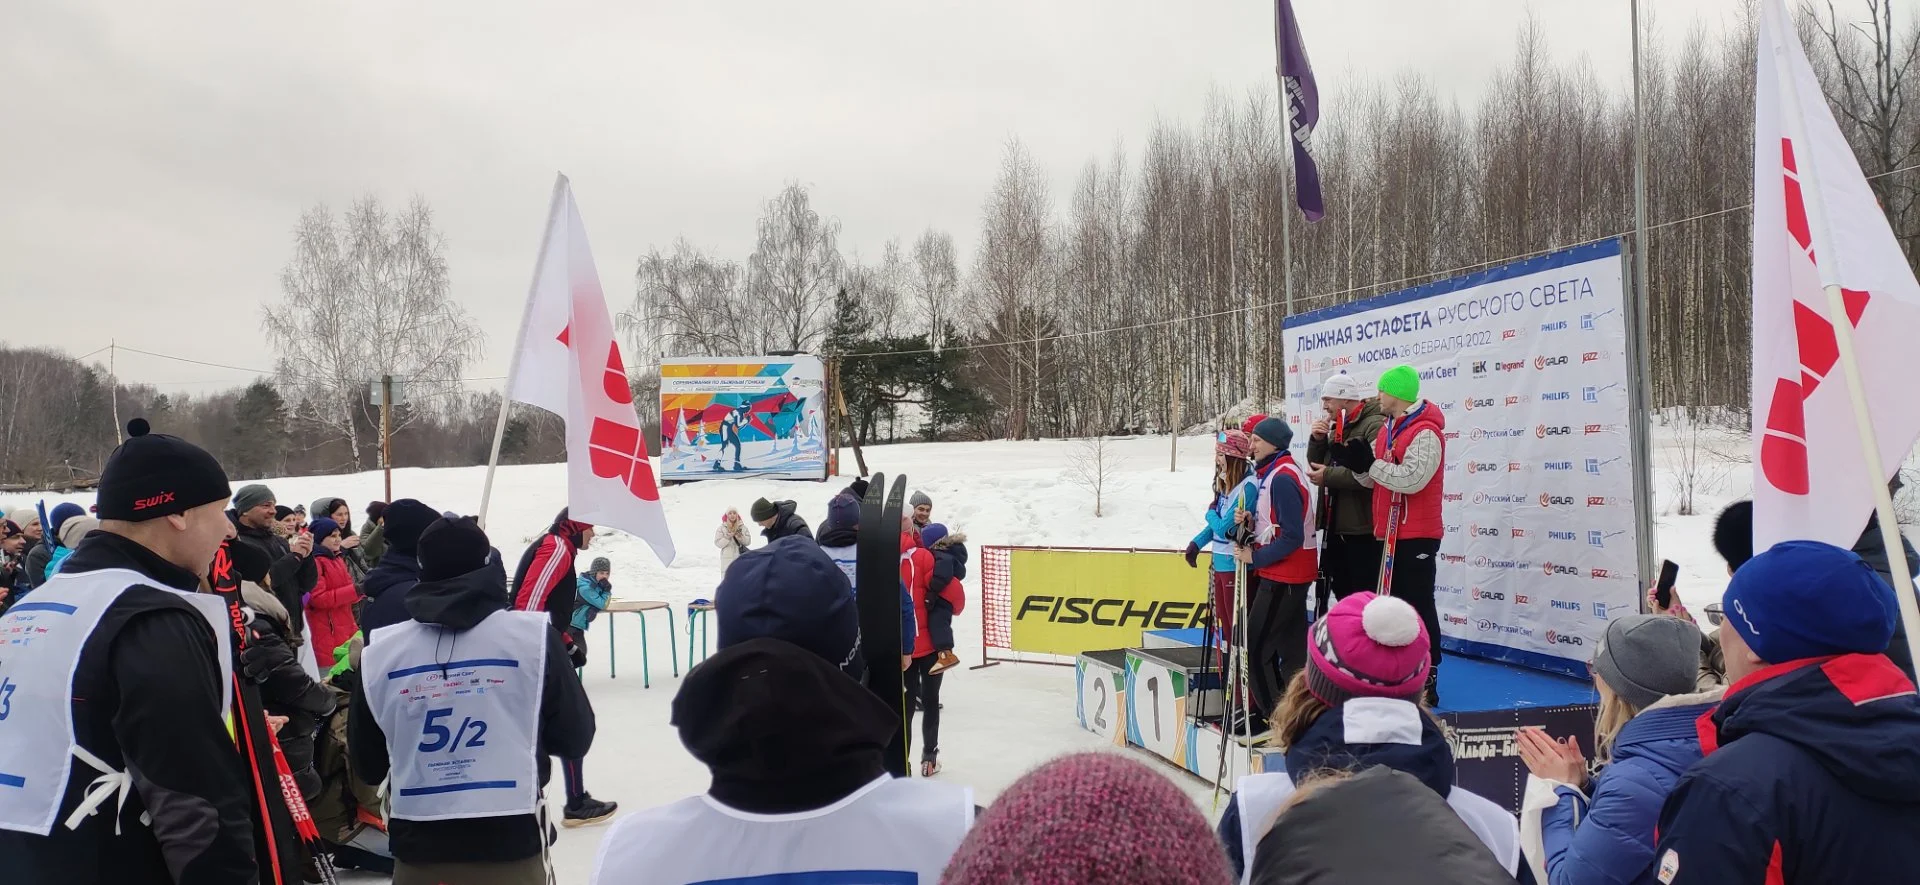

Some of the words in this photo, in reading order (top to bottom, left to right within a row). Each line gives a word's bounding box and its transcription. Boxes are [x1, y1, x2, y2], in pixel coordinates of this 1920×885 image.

[1297, 325, 1352, 352] ЛЫЖНАЯ
[1356, 310, 1432, 342] ЭСТАФЕТА
[1438, 291, 1524, 326] РУССКОГО
[1530, 277, 1594, 308] СВЕТА
[1541, 320, 1568, 332] PHILIPS
[1358, 348, 1398, 364] МОСКВА
[1400, 345, 1411, 357] 26
[1412, 335, 1462, 354] ФЕВРАЛЯ
[1466, 331, 1491, 346] 2022
[1501, 360, 1525, 372] legrand
[1436, 367, 1457, 379] Свет
[1542, 392, 1569, 401] PHILIPS
[1444, 430, 1459, 440] grand
[1483, 430, 1508, 439] Русский
[1509, 428, 1524, 437] Свет
[1546, 427, 1571, 435] GALAD
[1544, 462, 1573, 471] PHILIPS
[1485, 494, 1510, 504] Русский
[1550, 496, 1574, 504] GALAD
[1478, 528, 1498, 536] GALAD
[1548, 531, 1576, 540] PHILIPS
[1487, 559, 1515, 570] Русский
[1554, 566, 1578, 575] GALAD
[1480, 590, 1504, 601] GALAD
[1551, 600, 1580, 611] PHILIPS
[1493, 623, 1518, 634] Русский
[1519, 627, 1533, 636] Свет
[1557, 634, 1582, 646] GALAD
[1093, 677, 1107, 729] 2
[1147, 676, 1161, 742] 1
[418, 708, 488, 753] 5/2
[1461, 734, 1517, 743] Спортивны
[1457, 740, 1520, 761] Альфа-Би
[284, 774, 309, 820] ATOMIC
